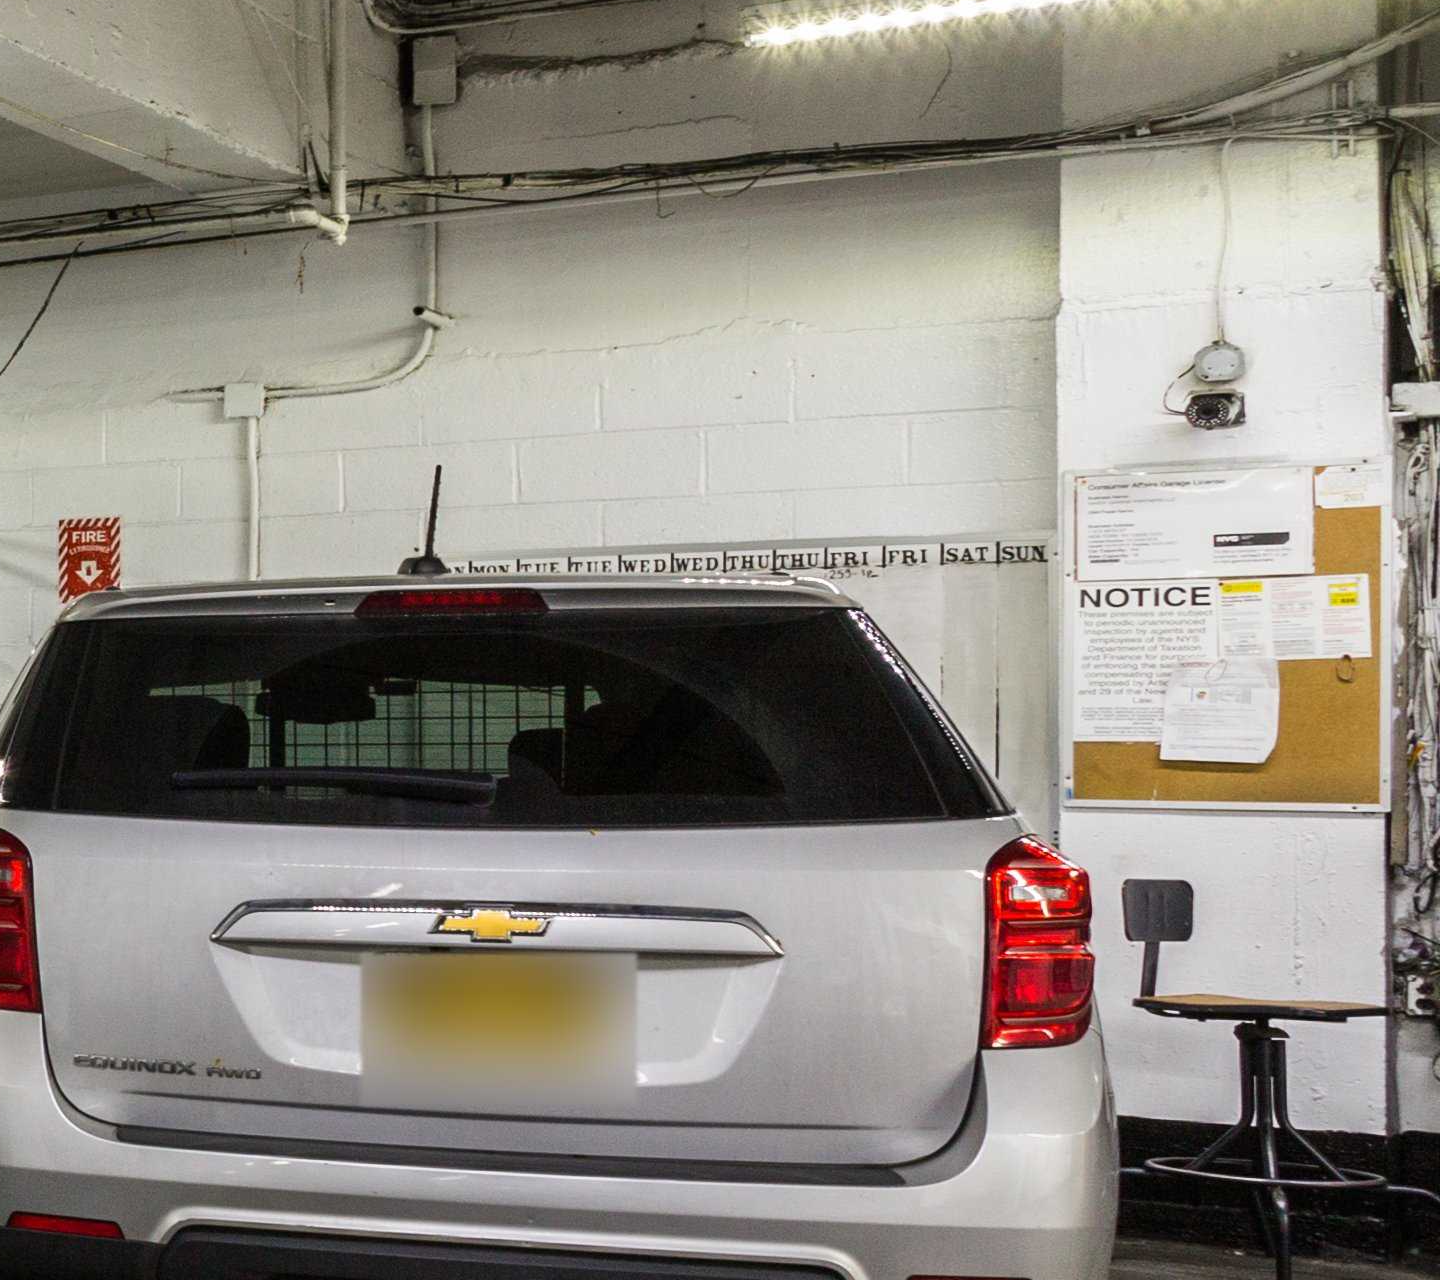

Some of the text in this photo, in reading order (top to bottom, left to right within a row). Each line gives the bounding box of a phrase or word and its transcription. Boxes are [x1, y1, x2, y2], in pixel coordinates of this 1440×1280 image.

[72, 530, 107, 543] FIRE
[521, 562, 560, 573] TUE
[570, 560, 611, 573] TUE
[622, 559, 666, 573] WED
[675, 557, 719, 571] WED
[728, 555, 771, 569] THU
[777, 553, 820, 568] THU
[830, 551, 869, 567] FRI
[888, 548, 928, 564] FRI
[945, 546, 989, 562] SAT
[1001, 544, 1047, 562] SUN
[1080, 587, 1211, 608] NOTICE
[73, 1053, 262, 1080] EQUINOX AWD
